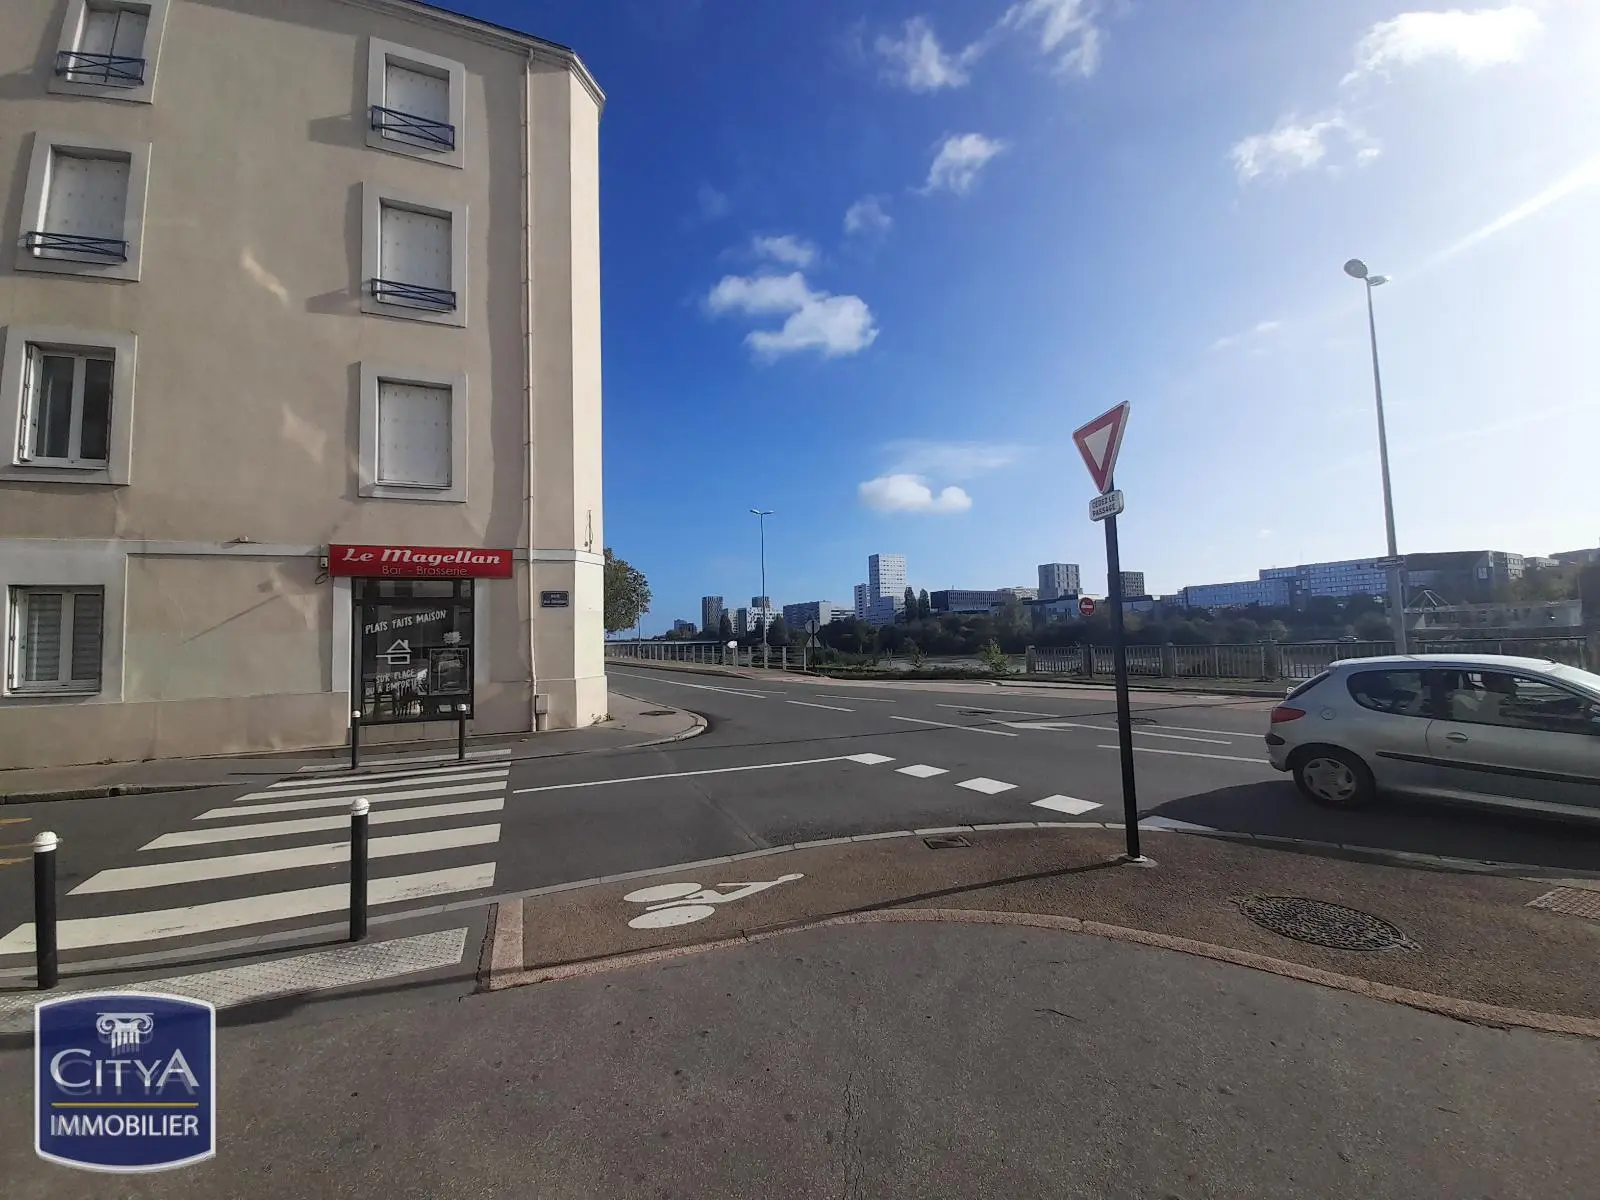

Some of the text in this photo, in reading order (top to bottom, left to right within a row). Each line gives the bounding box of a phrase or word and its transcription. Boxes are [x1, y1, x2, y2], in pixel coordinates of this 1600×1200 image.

[1092, 503, 1116, 517] PASSAGE
[342, 548, 501, 566] Le Magellan
[382, 565, 402, 575] Bar
[416, 565, 468, 576] Brasserie
[365, 610, 447, 634] PLATS FAITS MAISON
